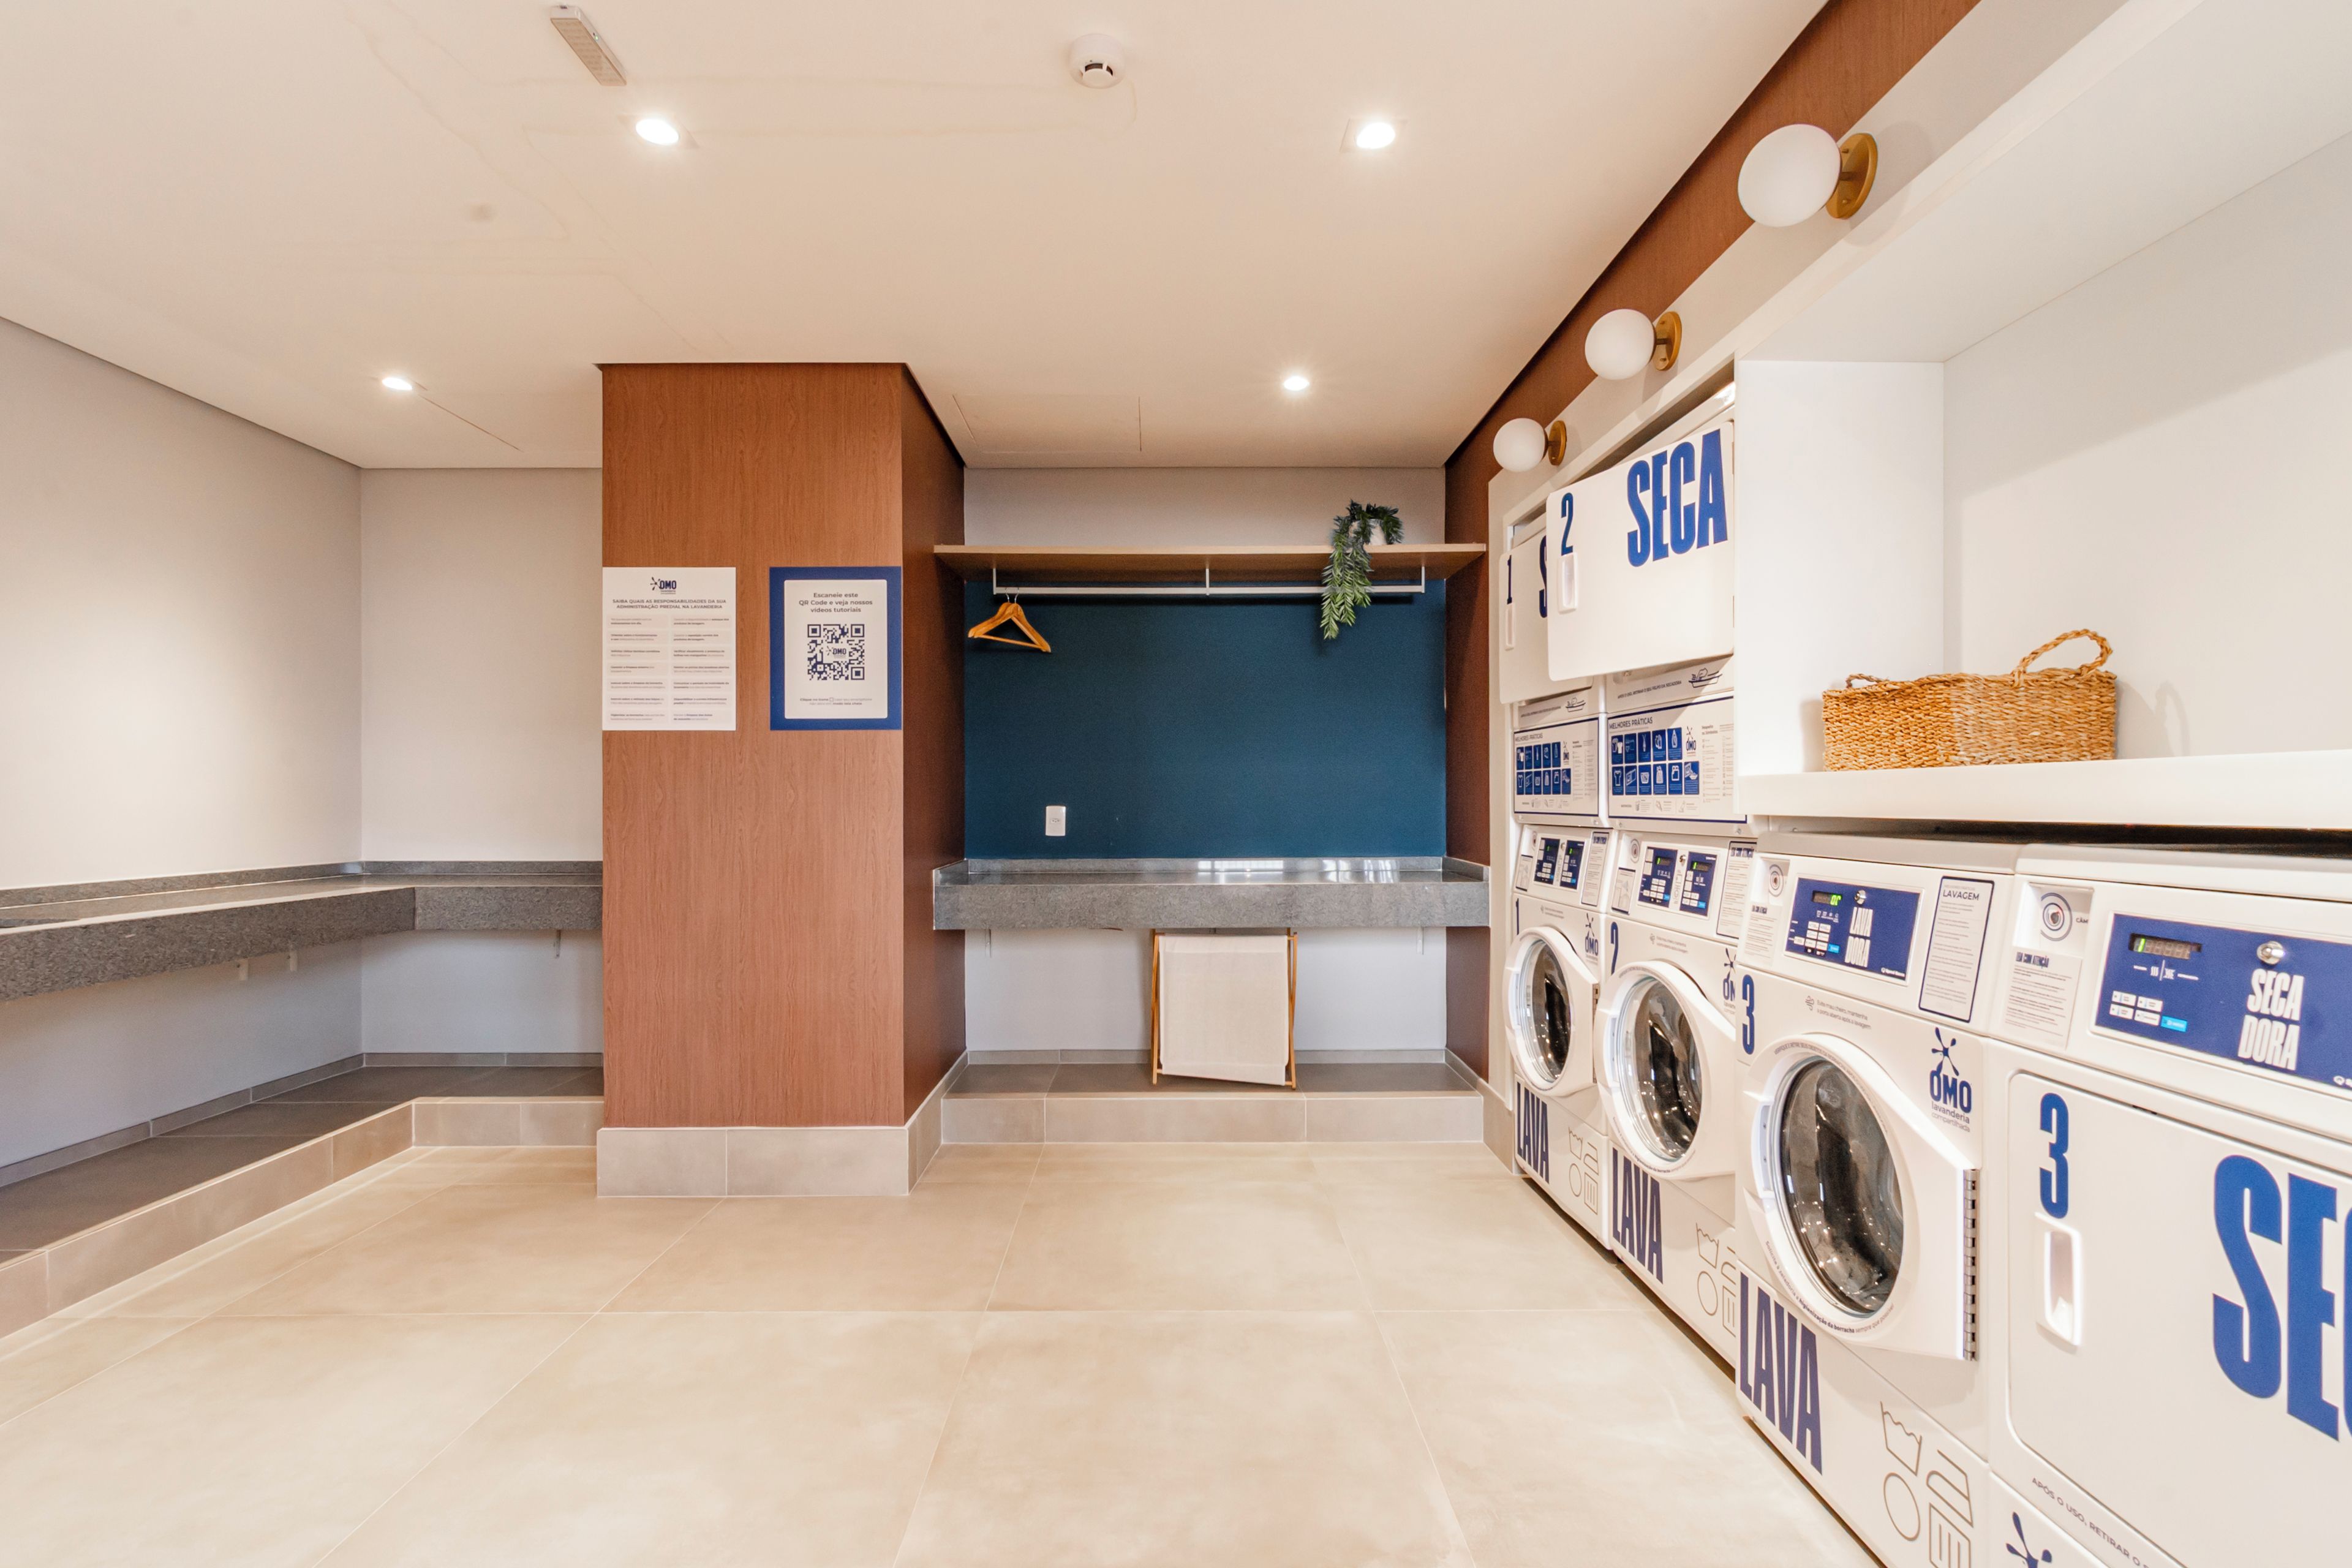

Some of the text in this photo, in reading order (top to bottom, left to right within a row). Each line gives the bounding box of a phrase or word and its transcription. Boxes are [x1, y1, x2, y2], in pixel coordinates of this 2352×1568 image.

[1627, 428, 1728, 567] SECA
[1561, 492, 1574, 557] 2
[660, 580, 677, 589] OMO
[1507, 554, 1512, 605] 1
[1609, 717, 1653, 729] MELHORES PRÁTICAS
[1686, 739, 1697, 752] OMO
[1943, 889, 1980, 901] LAVAGEM
[1585, 937, 1599, 956] OMO
[1850, 907, 1873, 937] LAVA
[1844, 935, 1871, 968] DORA
[1742, 974, 1754, 1055] 3
[2247, 968, 2304, 1021] SECA
[2237, 1014, 2301, 1071] DORA
[1929, 1070, 1972, 1114] OMO
[1931, 1101, 1970, 1124] lavanderia
[1517, 1081, 1550, 1185] LAVA
[1931, 1112, 1970, 1133] compartilhada
[2040, 1092, 2069, 1219] 3
[1613, 1147, 1663, 1284] LAVA
[1799, 1298, 1827, 1325] higienização
[1833, 1324, 1855, 1333] borracha
[2212, 1155, 2352, 1442] SE
[1740, 1271, 1822, 1476] LAVA
[2032, 1477, 2140, 1566] APÓS O USO, RETIRAR O
